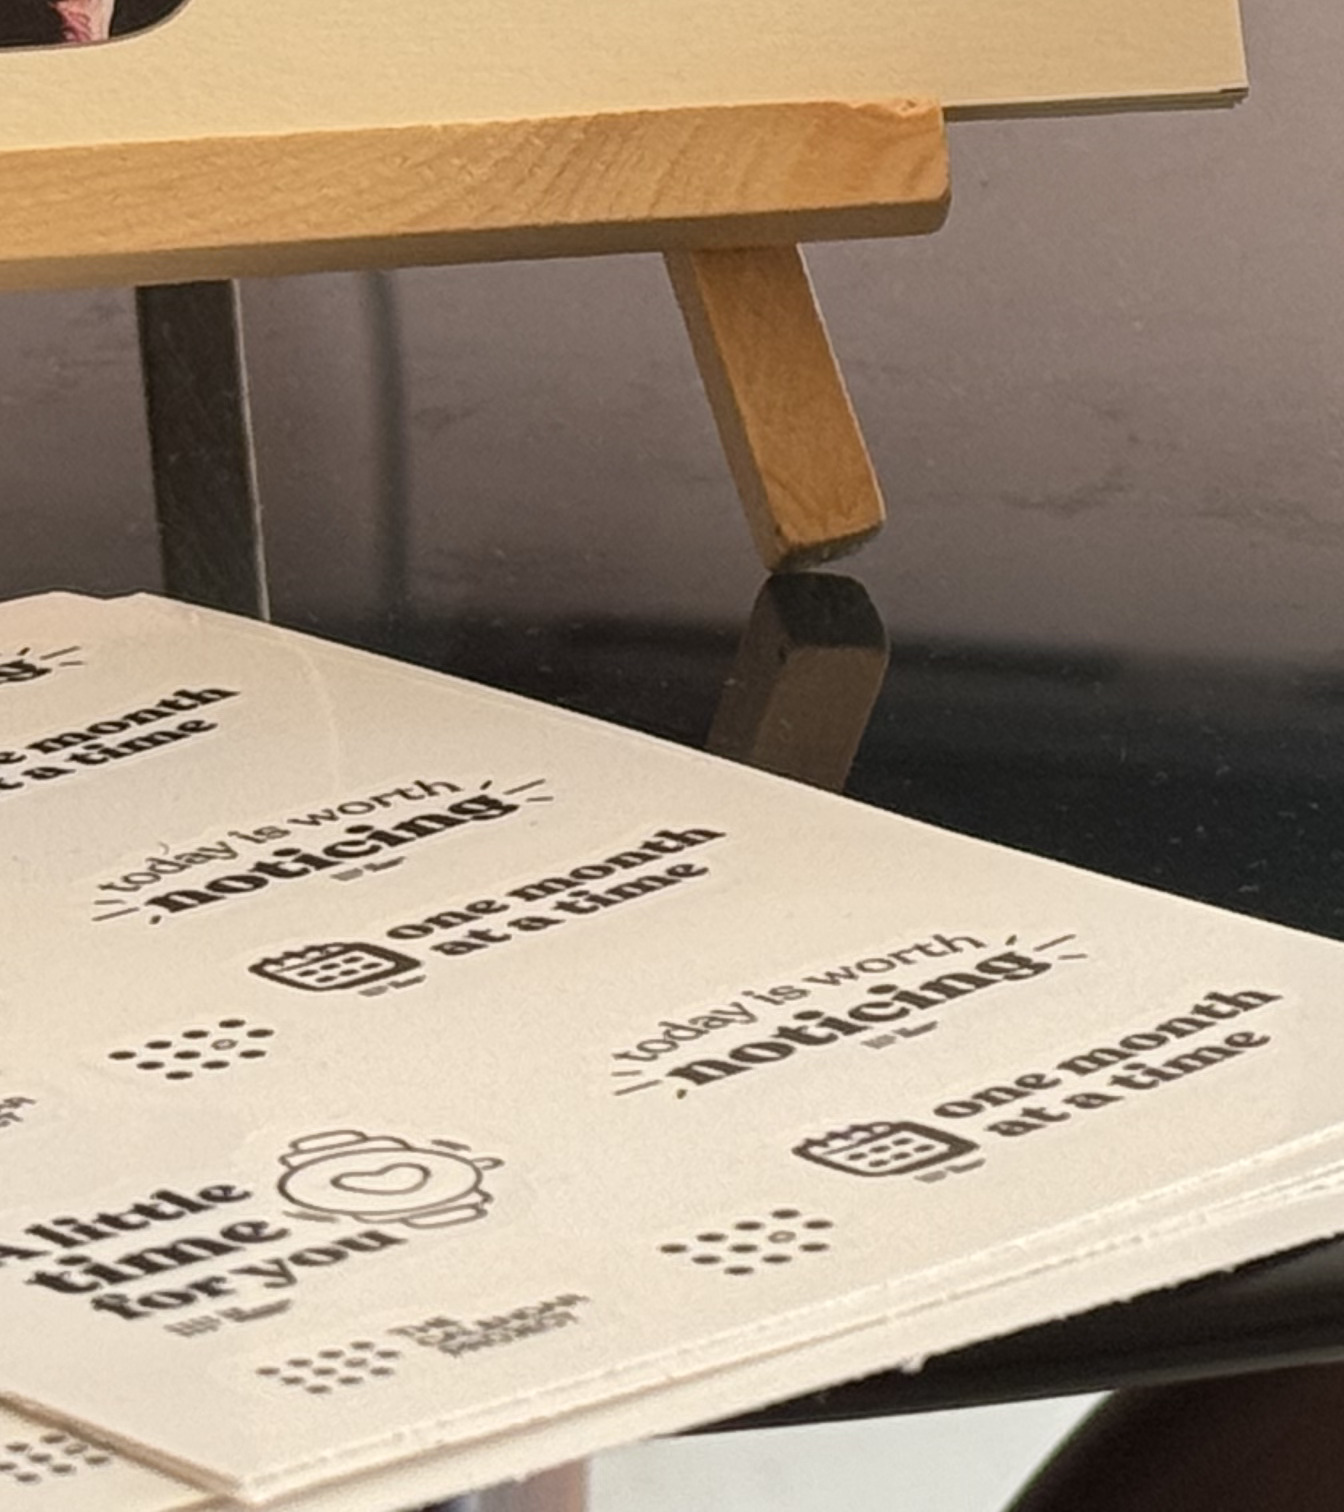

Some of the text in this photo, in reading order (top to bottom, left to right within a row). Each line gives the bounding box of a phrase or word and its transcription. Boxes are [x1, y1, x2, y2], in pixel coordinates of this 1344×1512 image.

[22, 767, 76, 779] a
[64, 719, 218, 765] time
[25, 688, 241, 754] month
[98, 780, 462, 893] today is worth
[145, 794, 520, 913] noticing
[386, 828, 727, 939] one month
[429, 863, 709, 956] at a time
[611, 933, 987, 1062] today is worth
[666, 950, 1053, 1086] noticing
[933, 991, 1284, 1118] one month
[983, 1031, 1271, 1137] at a time
[24, 1184, 252, 1248] little
[25, 1220, 291, 1294] time
[90, 1276, 237, 1320] for
[228, 1230, 407, 1289] you
